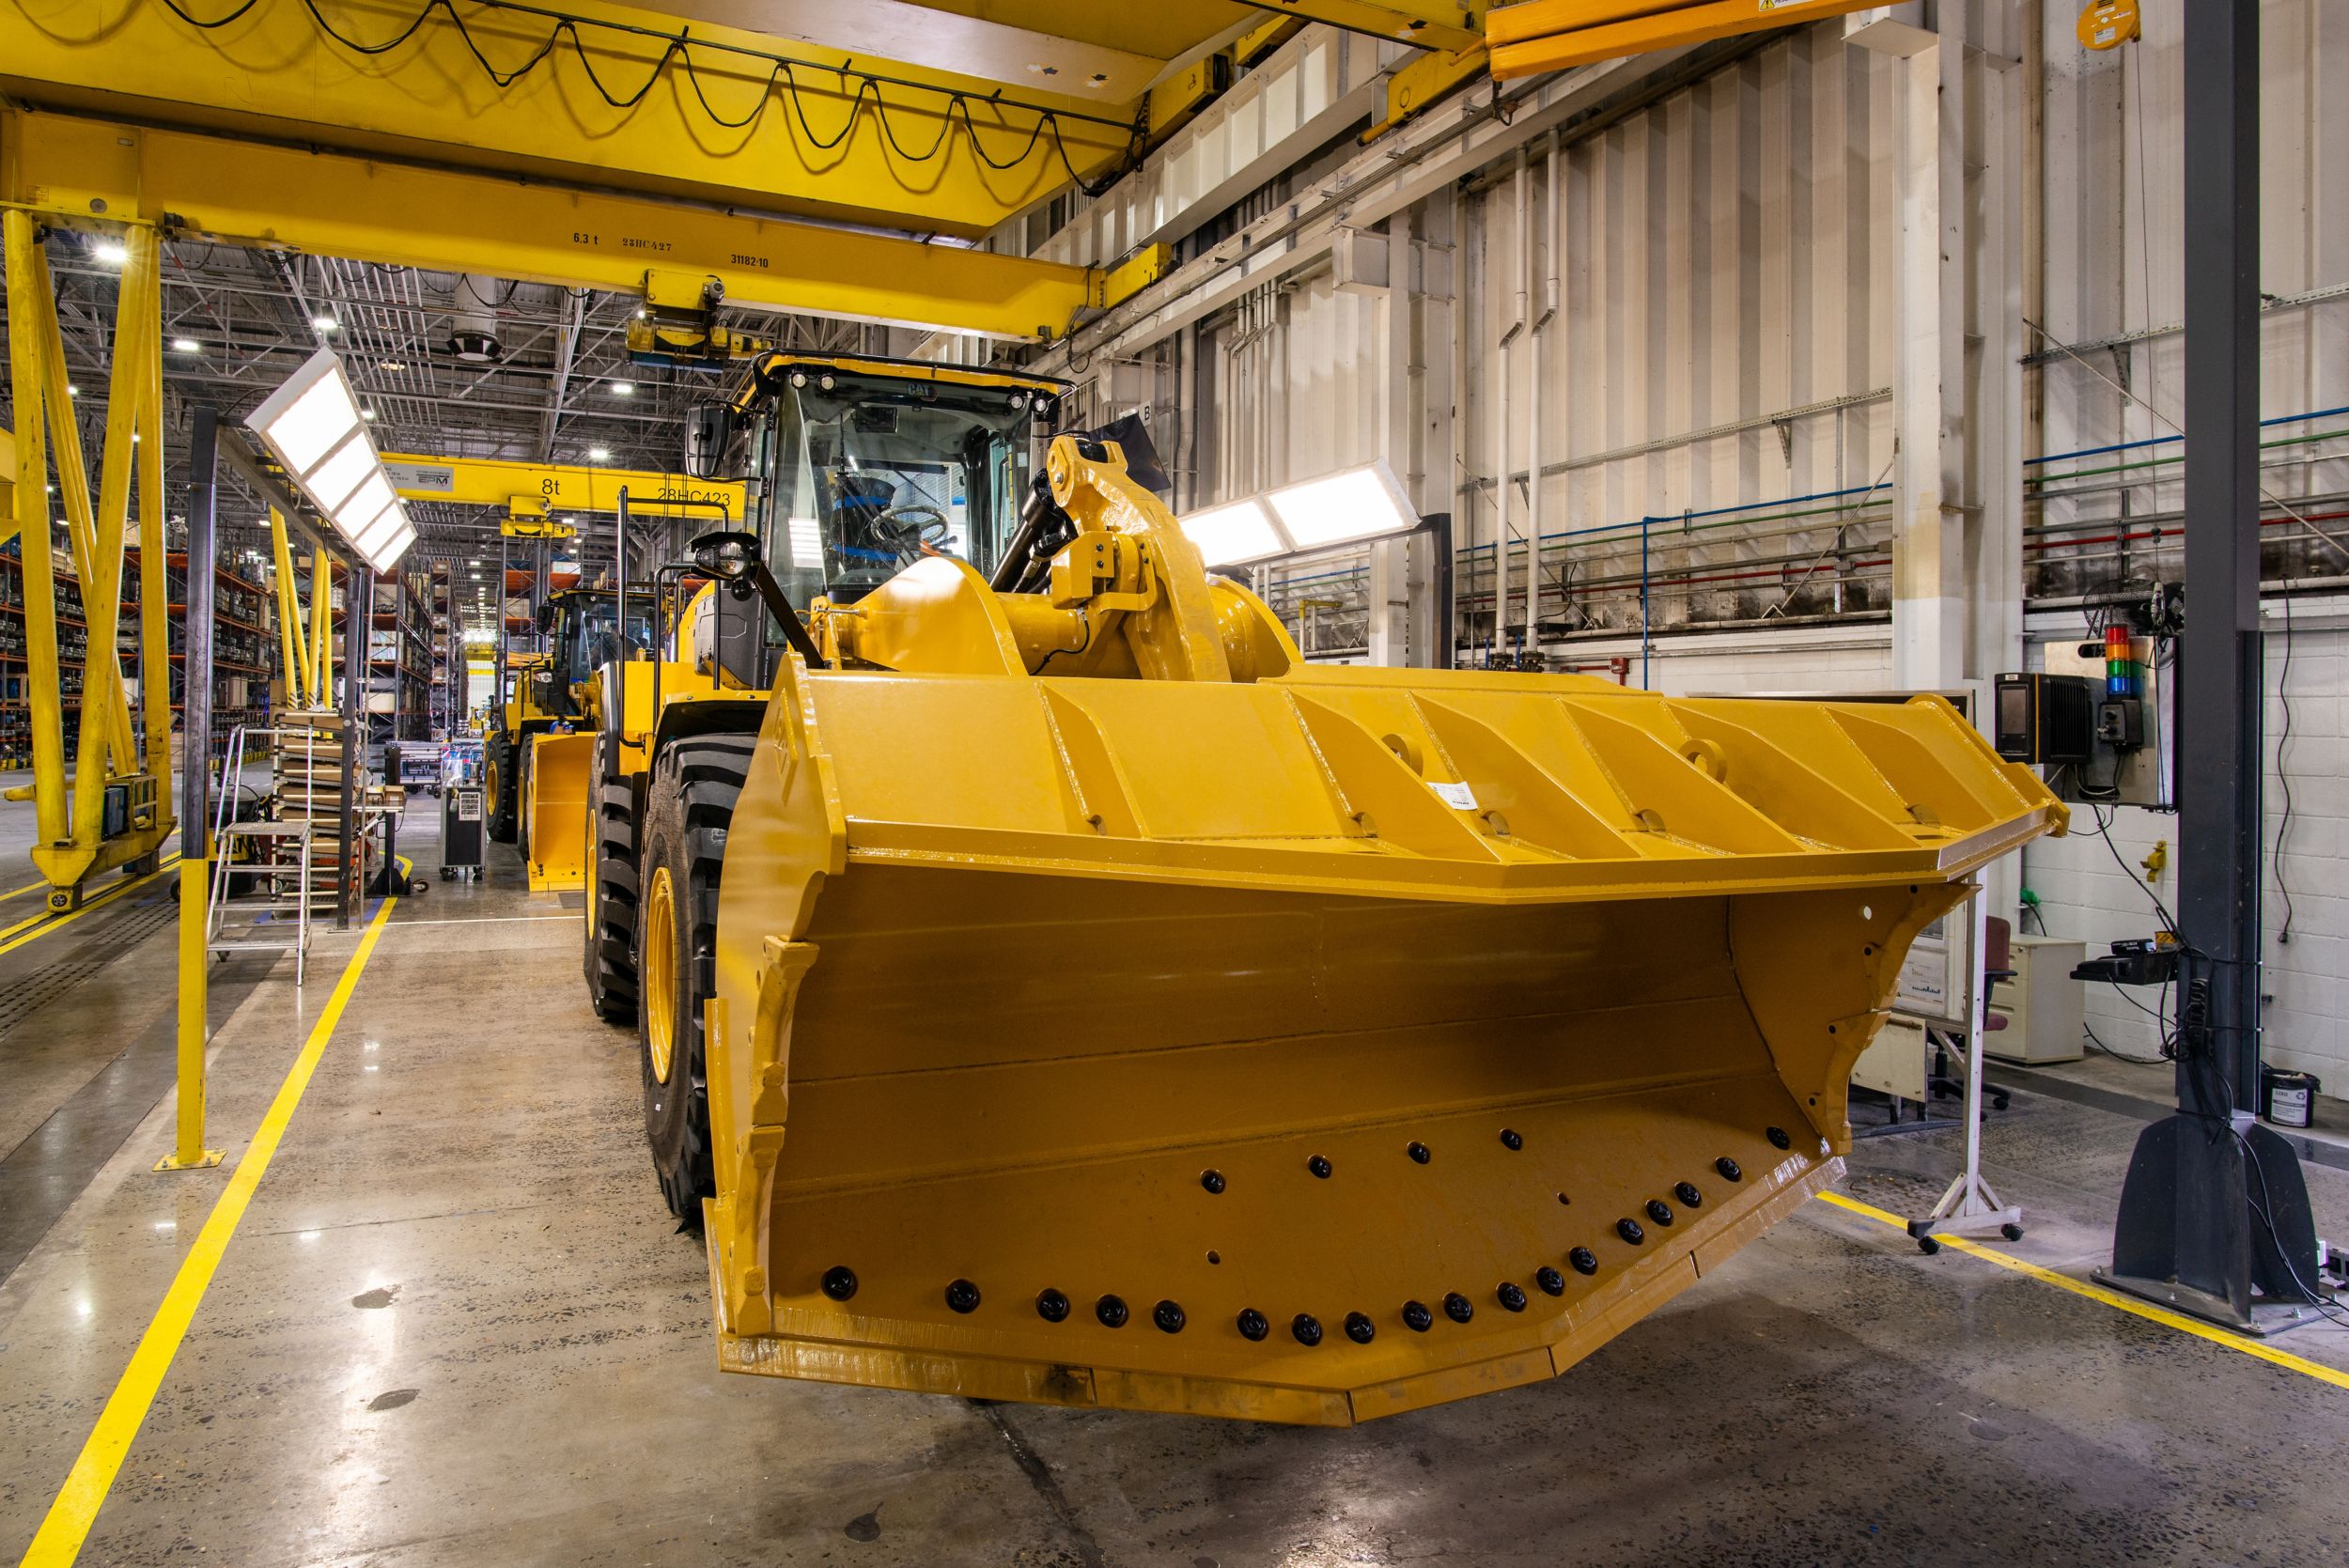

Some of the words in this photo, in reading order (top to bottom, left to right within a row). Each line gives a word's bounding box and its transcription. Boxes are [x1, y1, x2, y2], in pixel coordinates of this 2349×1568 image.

[573, 232, 589, 244] 6.3
[594, 235, 599, 244] t
[622, 238, 672, 251] 28HC427
[730, 254, 769, 268] 31182-10
[908, 382, 932, 396] CAT
[1144, 406, 1150, 420] B
[658, 488, 730, 506] 28HC423
